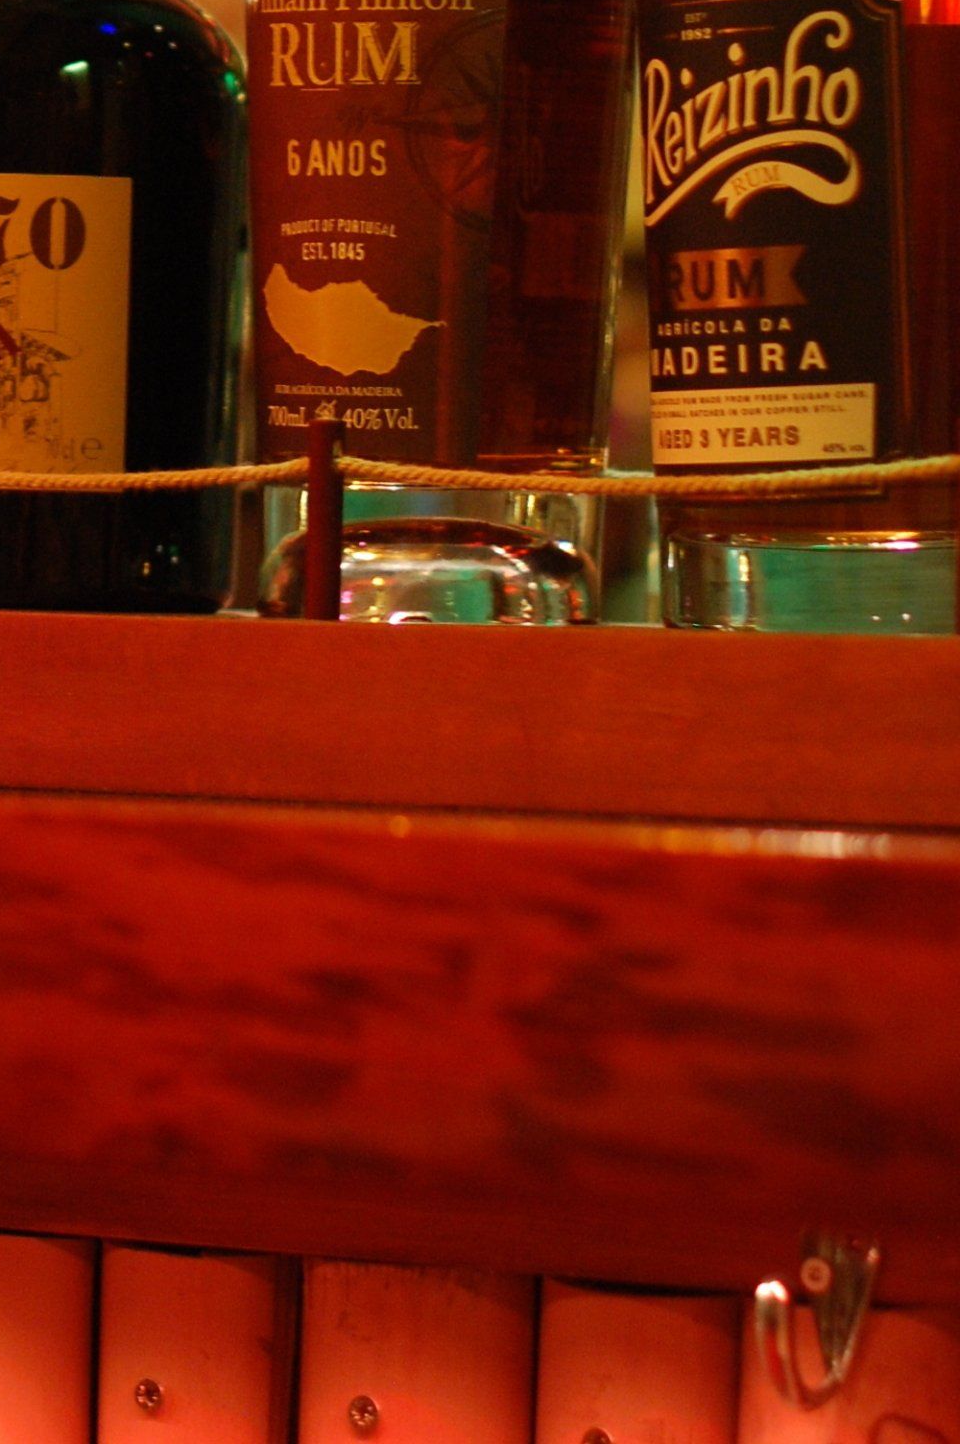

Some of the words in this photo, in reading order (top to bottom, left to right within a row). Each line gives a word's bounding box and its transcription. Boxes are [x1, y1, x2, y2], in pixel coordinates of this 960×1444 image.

[269, 21, 422, 87] RUM
[645, 10, 860, 204] Reizinho
[287, 138, 301, 177] 6
[306, 138, 387, 177] ANOS
[732, 163, 782, 197] RUM
[281, 218, 320, 236] PRODUCT
[322, 218, 334, 233] OF
[337, 218, 397, 238] PORTUGAL
[302, 242, 328, 261] EST.
[330, 242, 366, 261] 1845
[667, 258, 766, 302] RUM
[759, 317, 792, 333] DA
[342, 407, 382, 430] 40%
[383, 407, 419, 430] Vol.
[658, 428, 692, 449] AGED
[699, 428, 710, 449] 3
[716, 424, 800, 448] YEARS
